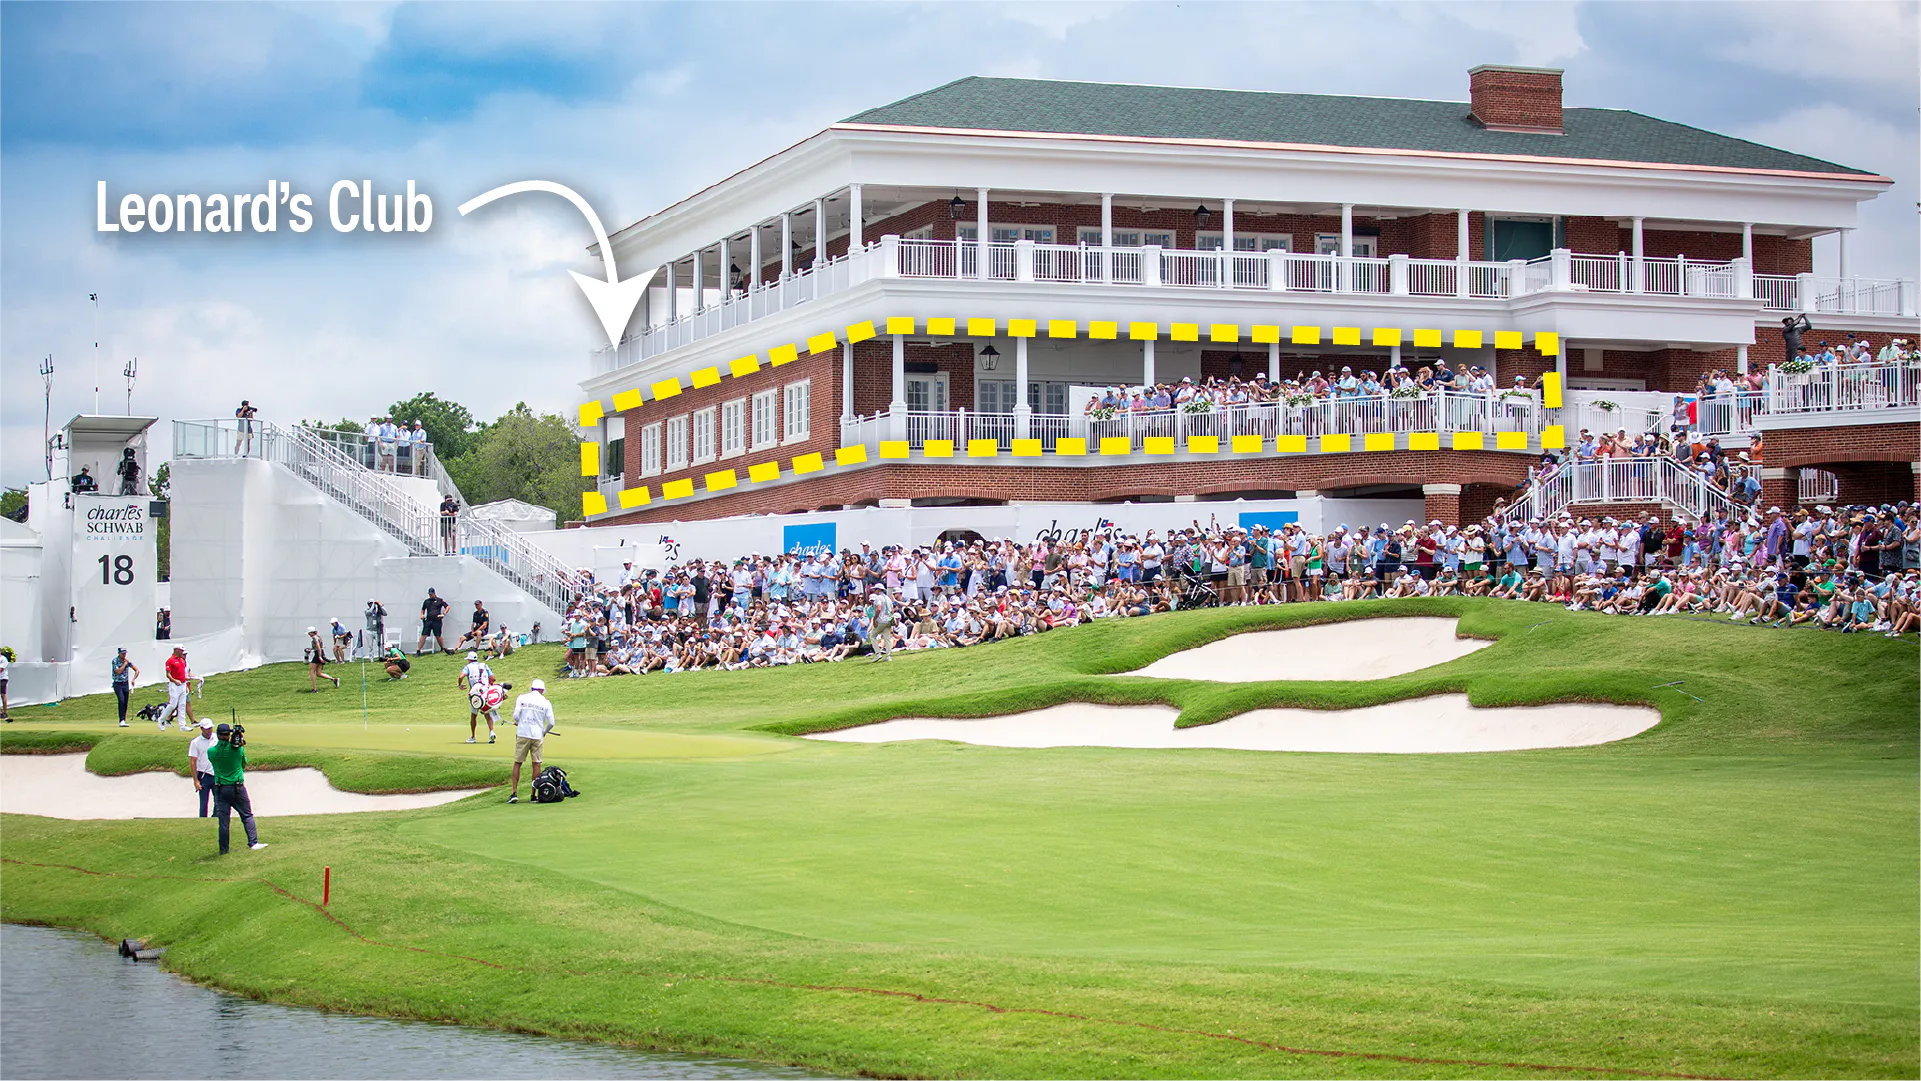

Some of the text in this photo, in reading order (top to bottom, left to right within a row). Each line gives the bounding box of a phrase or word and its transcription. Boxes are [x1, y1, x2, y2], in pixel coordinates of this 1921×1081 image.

[87, 504, 143, 520] charles
[87, 522, 143, 533] SCHWAB
[98, 555, 135, 585] 18
